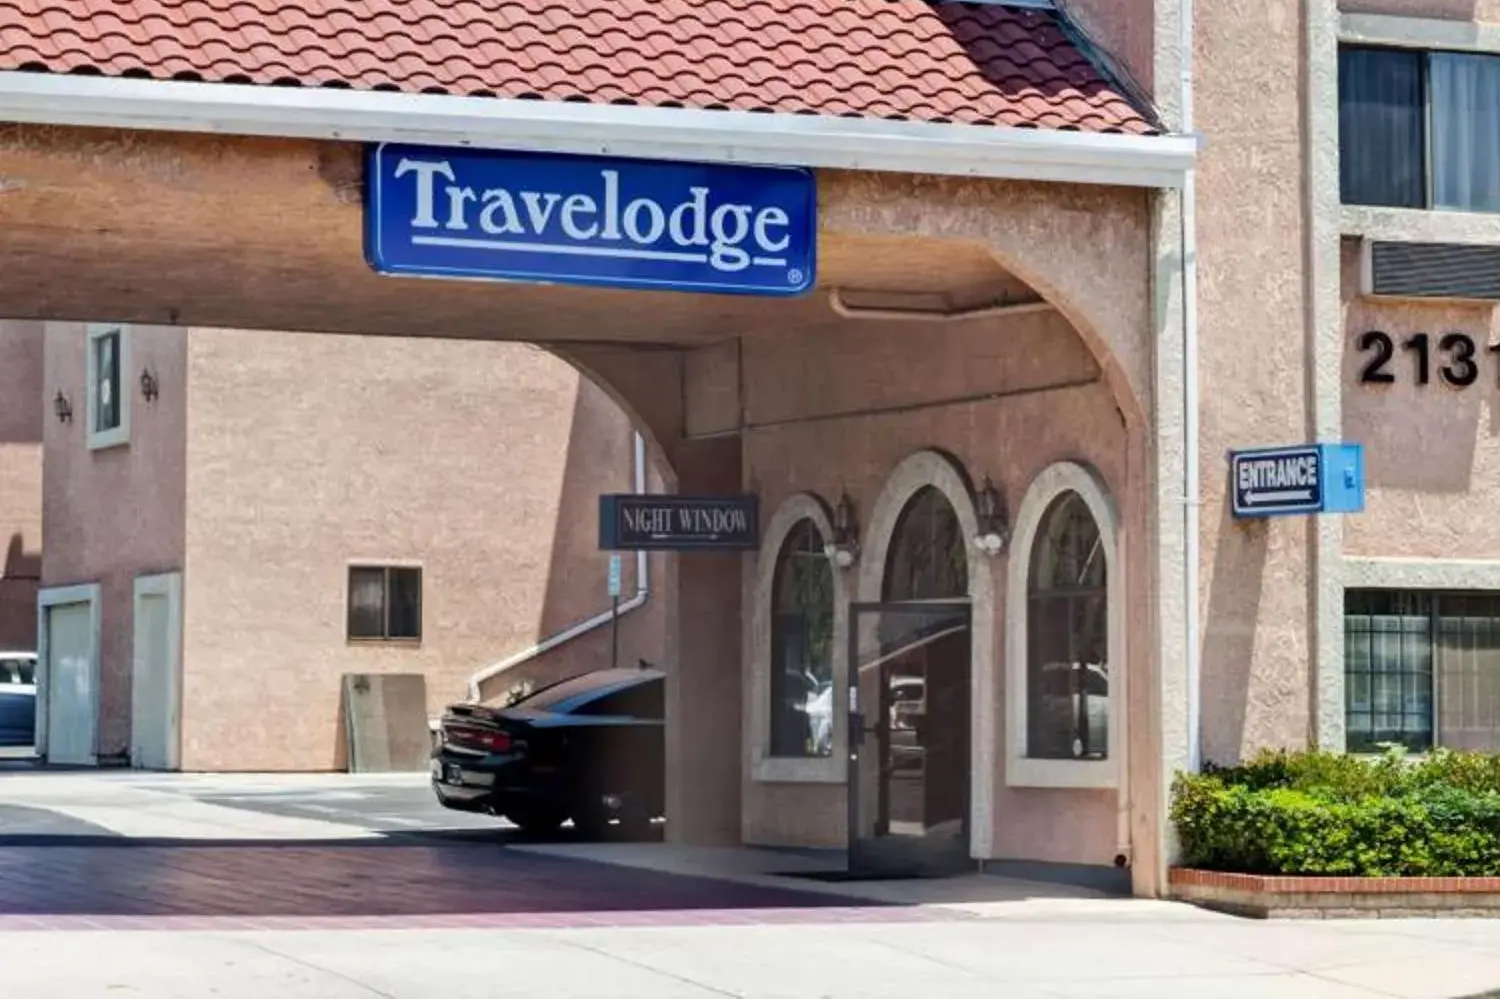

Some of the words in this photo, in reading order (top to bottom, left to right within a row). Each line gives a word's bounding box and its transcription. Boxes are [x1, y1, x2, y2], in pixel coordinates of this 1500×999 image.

[394, 157, 790, 272] Travelodge
[1239, 456, 1317, 490] ENTRANCE
[622, 507, 675, 533] NIGHT
[679, 507, 748, 533] WINDOW
